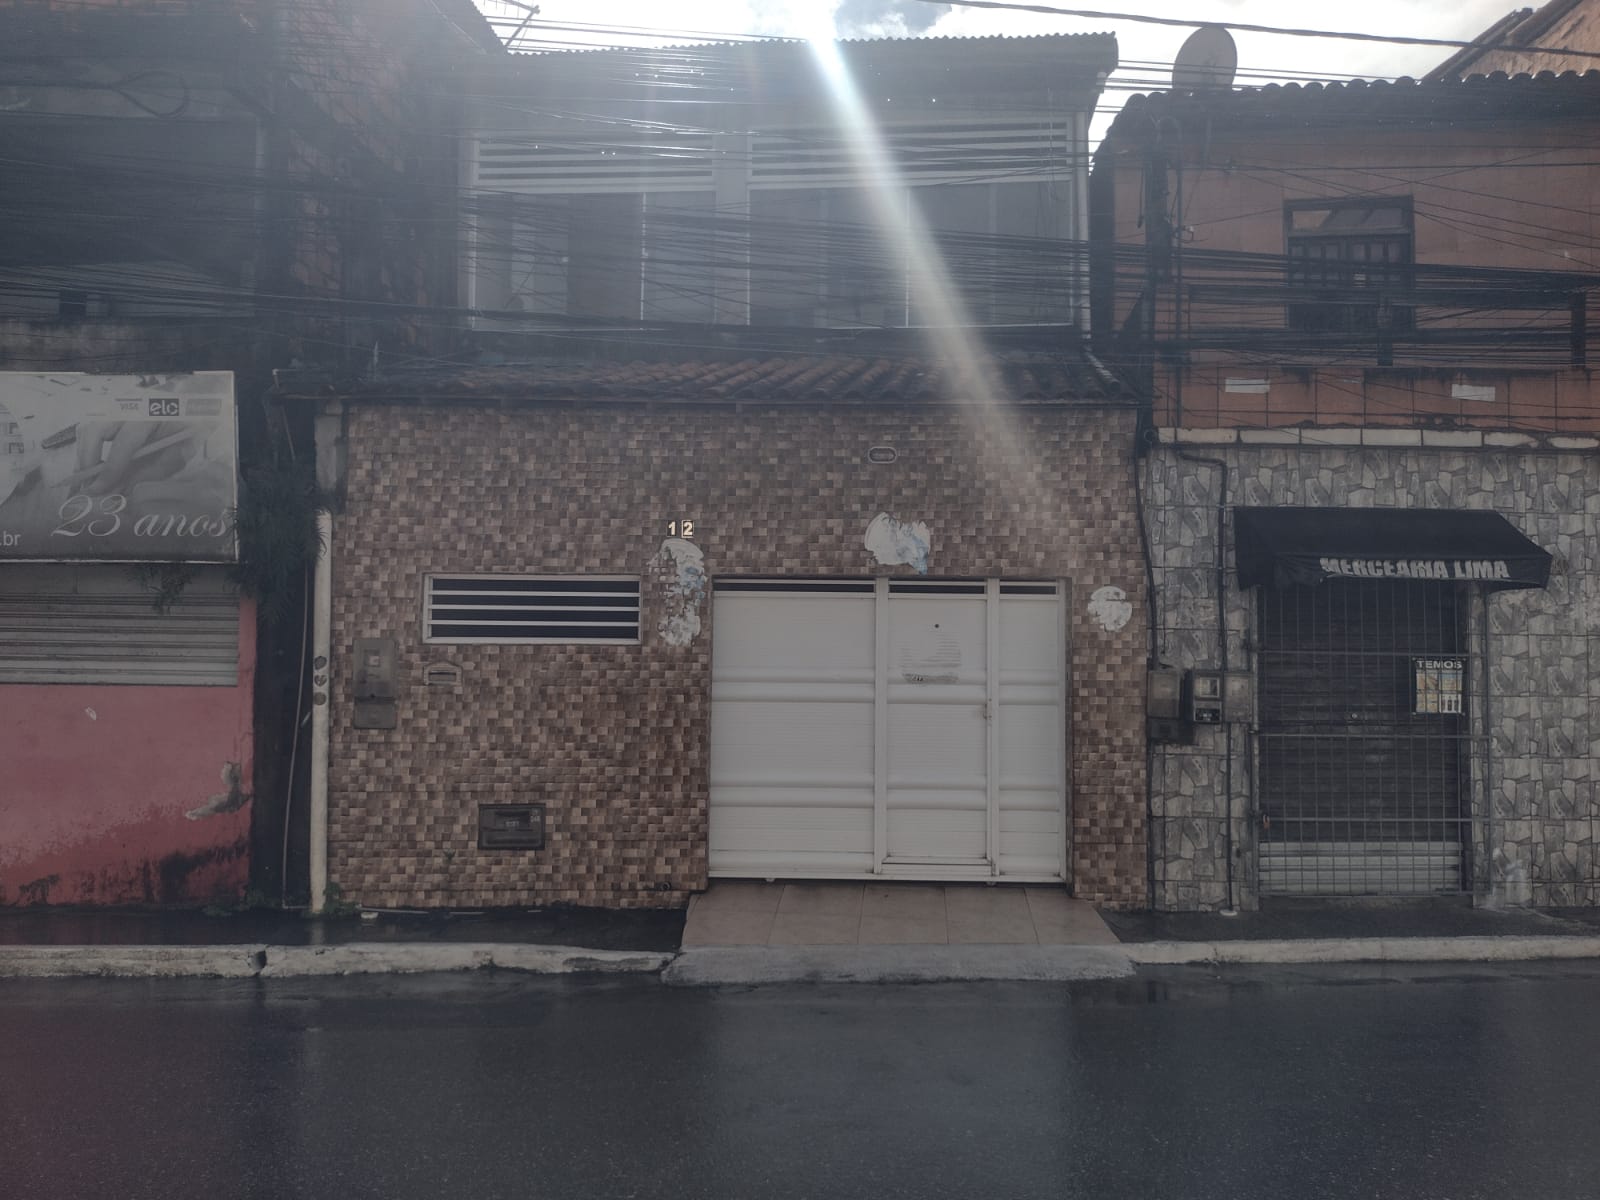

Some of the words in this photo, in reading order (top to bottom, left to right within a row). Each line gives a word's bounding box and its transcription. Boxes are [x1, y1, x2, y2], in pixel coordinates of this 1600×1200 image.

[51, 494, 127, 537] 23
[133, 509, 231, 537] anos
[668, 521, 694, 536] 12
[1320, 557, 1450, 579] MERCEARIA
[1453, 559, 1511, 580] LIMA
[1416, 660, 1463, 670] TEMOS
